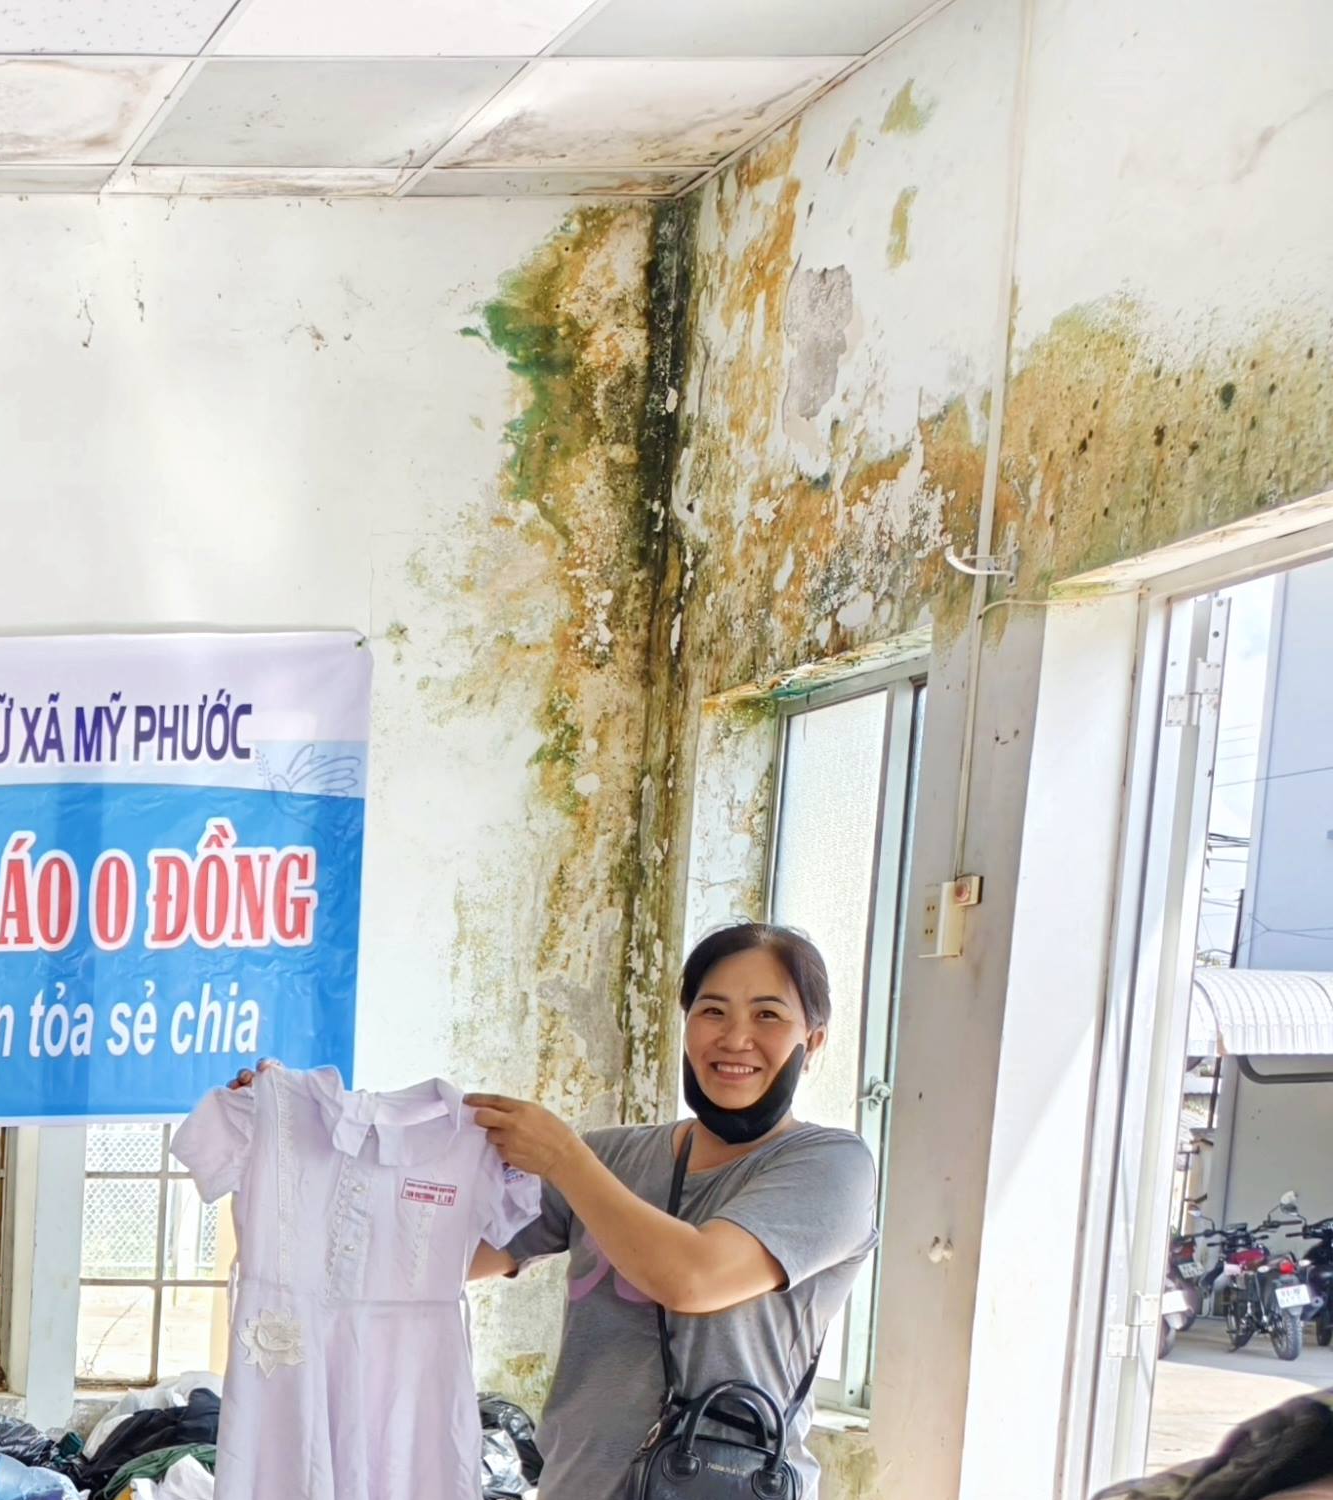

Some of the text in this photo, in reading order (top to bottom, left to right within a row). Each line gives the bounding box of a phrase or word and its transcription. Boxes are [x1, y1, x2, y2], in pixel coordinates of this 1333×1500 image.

[18, 690, 66, 764] XÃ
[72, 690, 128, 764] MỸ
[132, 687, 254, 763] PHƯỚC
[148, 823, 311, 944] ĐỒNG
[28, 980, 96, 1058] tỏa
[105, 979, 159, 1057] sẻ
[169, 981, 261, 1055] chia
